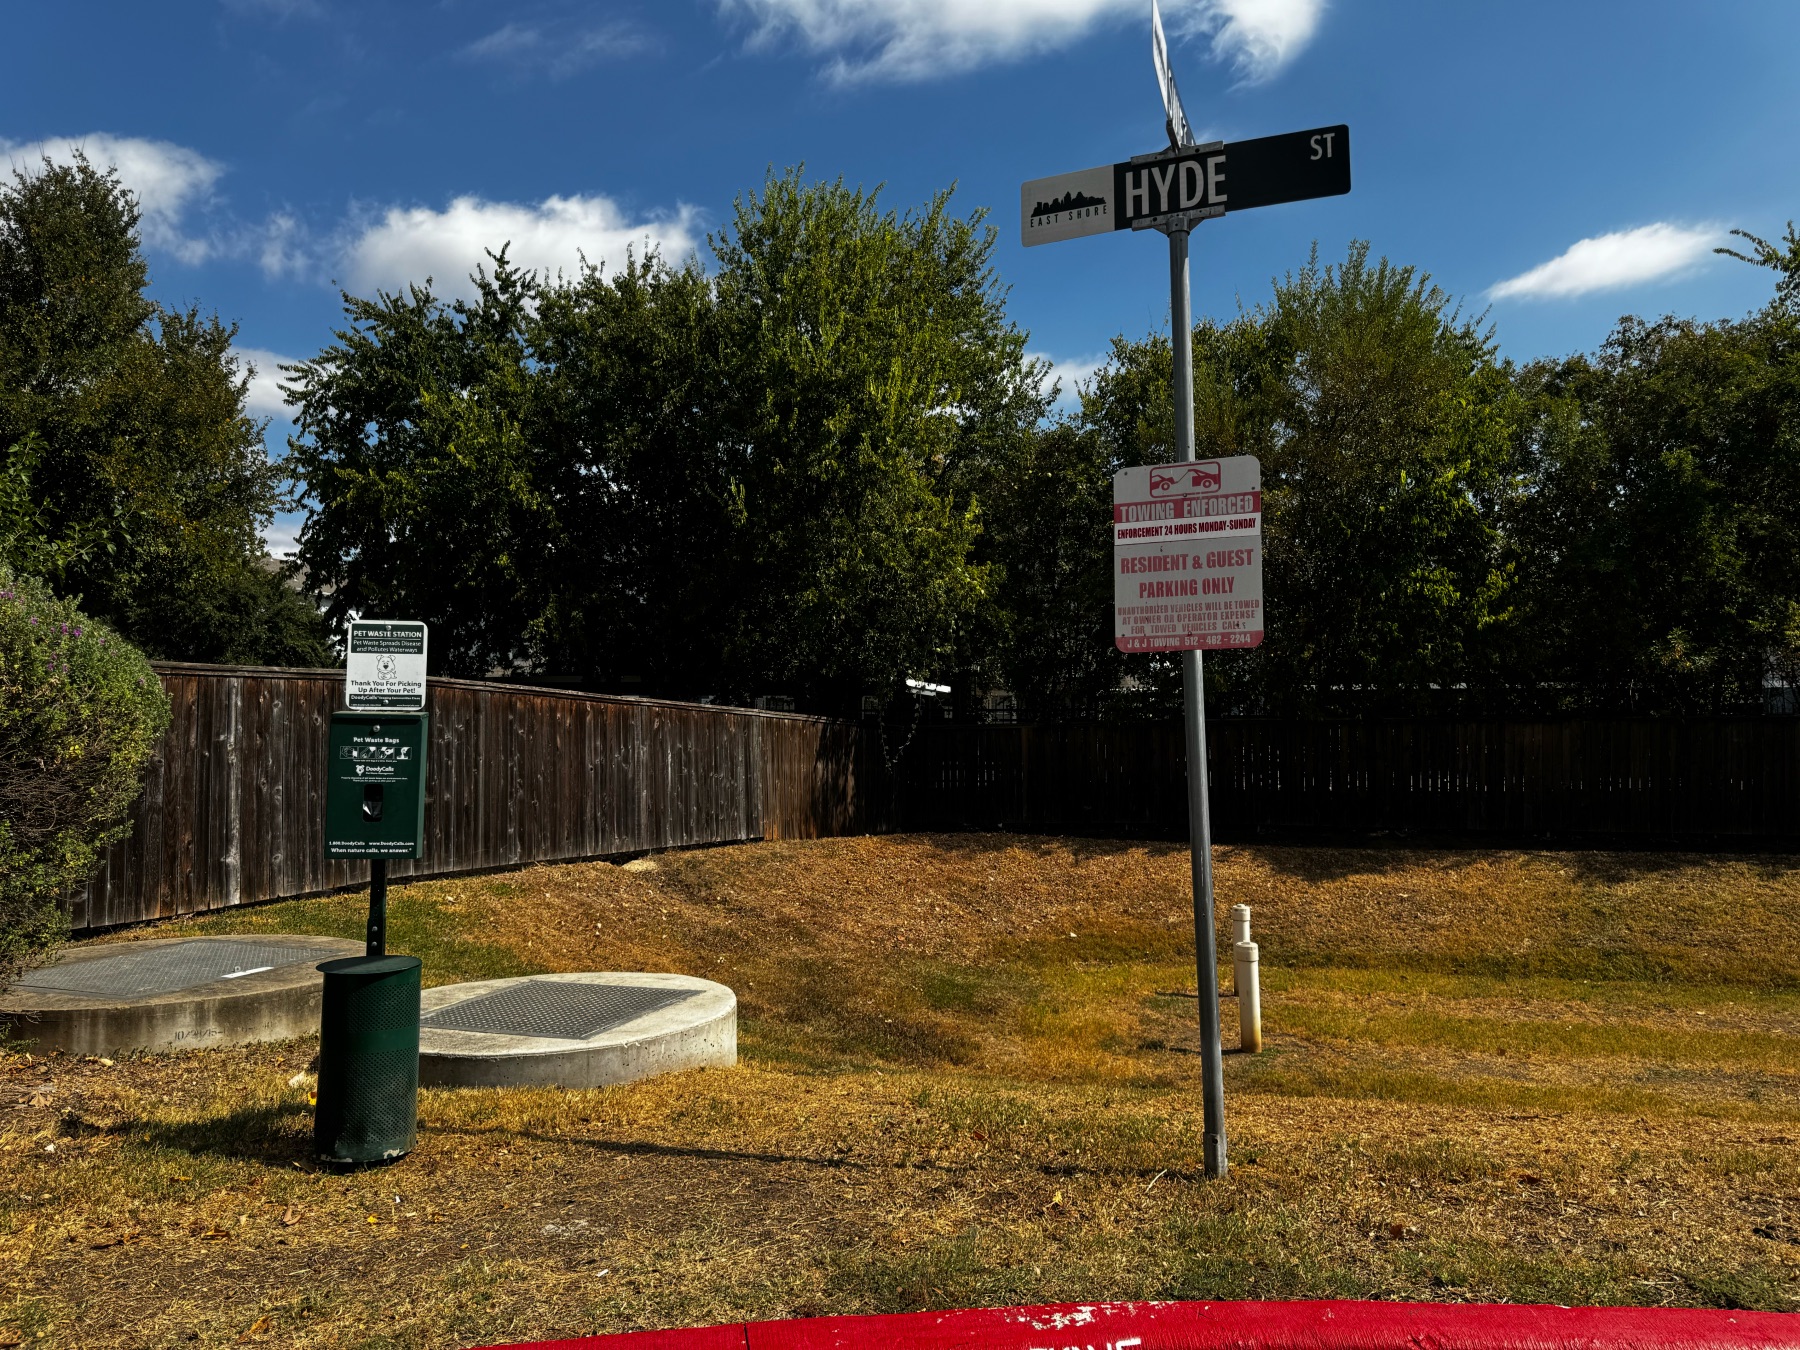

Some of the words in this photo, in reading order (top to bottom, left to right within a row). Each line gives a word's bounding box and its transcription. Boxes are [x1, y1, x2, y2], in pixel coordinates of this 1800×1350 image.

[1125, 155, 1228, 218] HYDE
[1310, 133, 1336, 161] ST
[1030, 214, 1060, 228] EAST
[1068, 204, 1108, 221] SHORE
[1120, 502, 1175, 523] TOWING
[1184, 495, 1254, 518] ENFORCED
[1117, 525, 1163, 540] ENFORCEMENT
[1164, 524, 1173, 536] 24
[1174, 523, 1197, 535] HOURS
[1199, 518, 1257, 533] MONDAY-SUNDAY
[1121, 554, 1189, 575] RESIDENT
[1192, 555, 1203, 570] &
[1206, 549, 1254, 569] GUEST
[1139, 579, 1198, 599] PARKING
[1202, 576, 1235, 595] ONLY
[1118, 605, 1169, 616] UNAUTHORIZED
[1170, 602, 1203, 613] VEHICLES
[1205, 601, 1223, 611] WILL
[1224, 601, 1233, 610] BE
[1234, 599, 1260, 610] TOWED
[1122, 616, 1133, 625] AT
[1133, 614, 1162, 625] OWNER
[1164, 613, 1175, 623] OR
[1177, 612, 1218, 623] OPERATOR
[1220, 610, 1256, 621] EXPENSE
[1131, 625, 1145, 635] FOR
[1151, 624, 1177, 634] TOWED
[1182, 622, 1217, 633] VEHICLES
[1127, 638, 1133, 648] J
[1134, 638, 1140, 648] &
[1142, 638, 1147, 648] J
[1149, 637, 1180, 648] TOWING
[1184, 636, 1199, 646] 512
[1230, 633, 1251, 644] 2244
